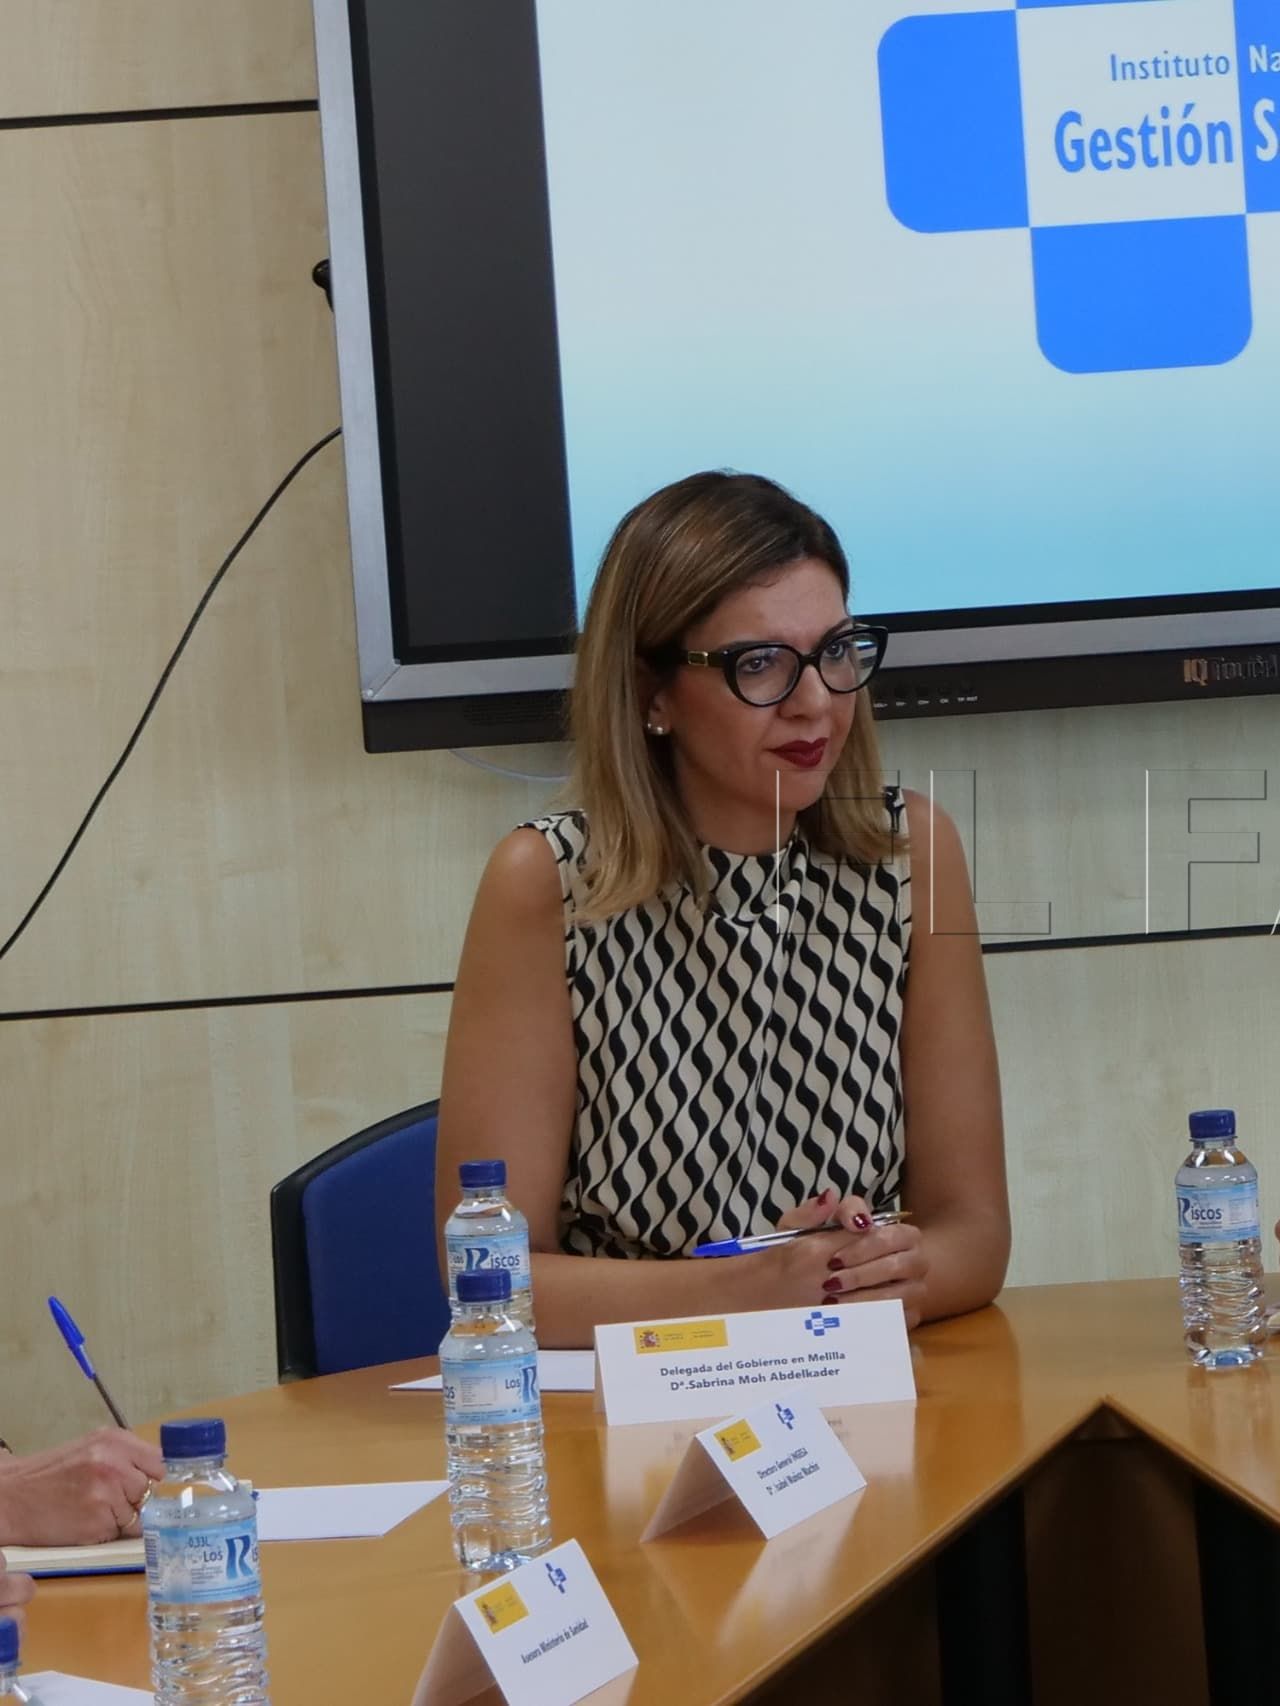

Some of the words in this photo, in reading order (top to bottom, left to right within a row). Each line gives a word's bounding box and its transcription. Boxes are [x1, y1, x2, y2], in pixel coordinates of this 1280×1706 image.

[1110, 51, 1231, 82] Instituto
[1054, 103, 1234, 173] Gestión
[660, 1366, 713, 1377] Delegada
[716, 1362, 733, 1372] del
[736, 1358, 788, 1370] Gobierno
[792, 1356, 805, 1364] en
[808, 1351, 846, 1362] Melilla
[739, 1372, 767, 1385] Moh
[770, 1367, 841, 1381] Abdelkader
